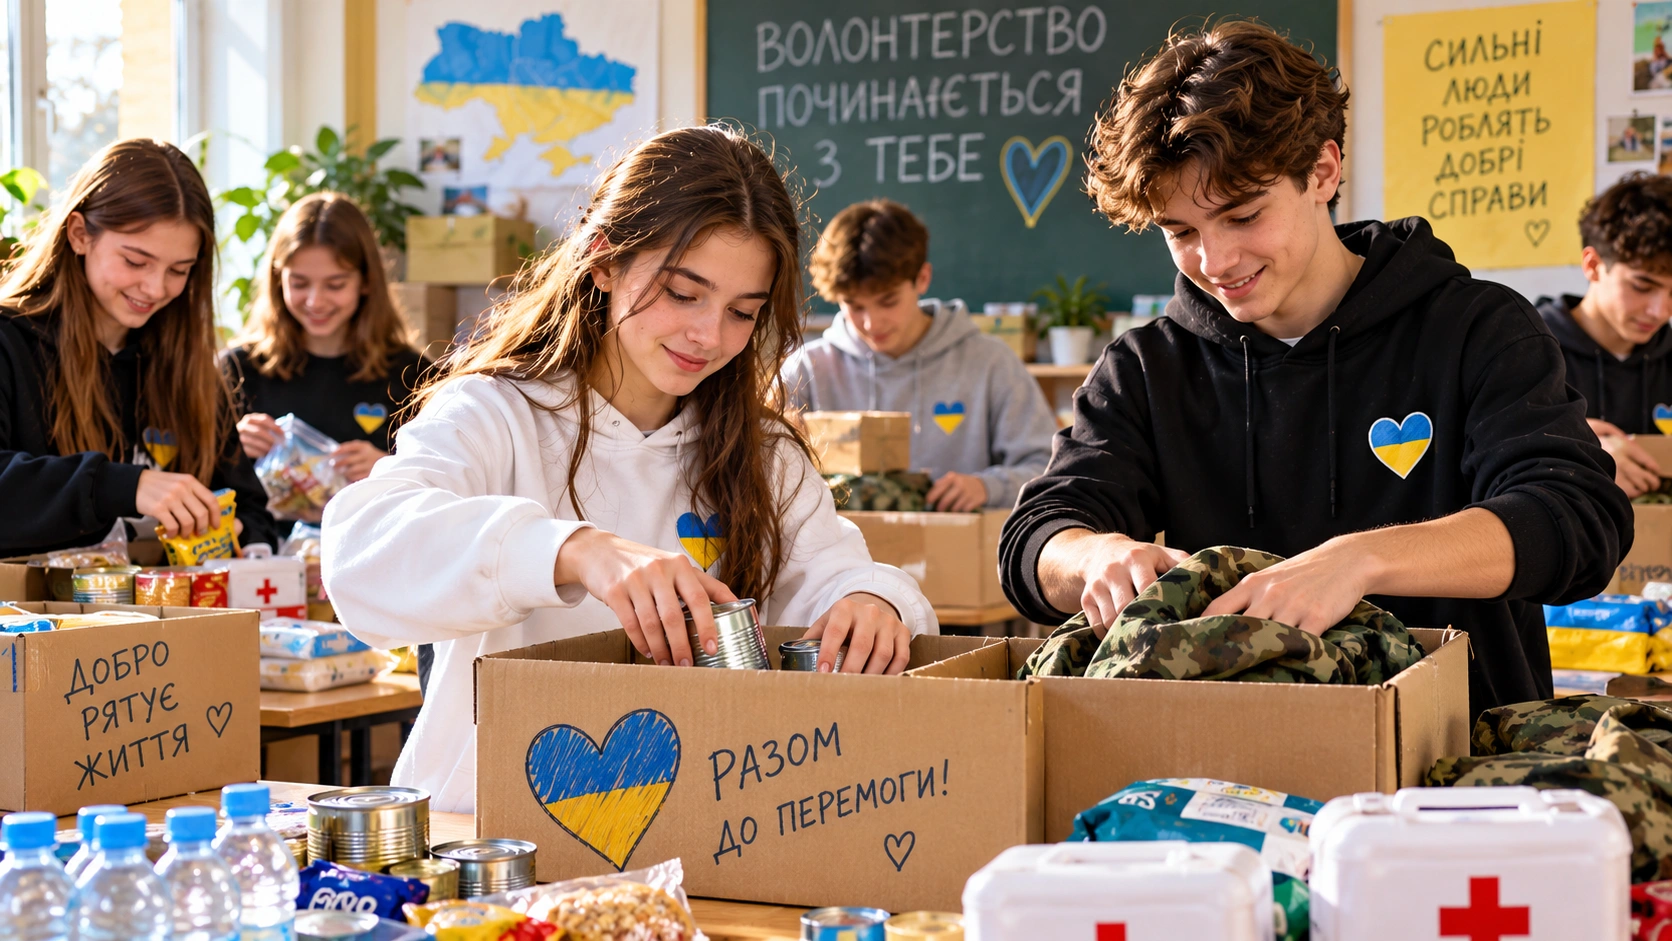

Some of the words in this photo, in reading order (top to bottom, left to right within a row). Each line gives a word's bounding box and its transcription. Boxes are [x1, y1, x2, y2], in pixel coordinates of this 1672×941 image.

[756, 5, 1107, 72] ВОЛОНТЕРСТВО
[1424, 20, 1543, 71] СИЛЬНІ
[1442, 70, 1531, 107] ЛЮДИ
[1421, 107, 1551, 146] РОБЛЯТЬ
[865, 133, 985, 183] ТЕБЕ
[1435, 139, 1524, 185] ДОБРІ
[1428, 181, 1548, 220] СПРАВИ
[64, 641, 169, 704] ДОБРО
[81, 682, 179, 741] РЯТУЄ
[74, 723, 189, 790] ЖИТТЯ
[708, 722, 842, 801] РАЗОМ
[713, 816, 758, 866] ДО
[776, 758, 949, 836] ПЕРЕМОГИ!
